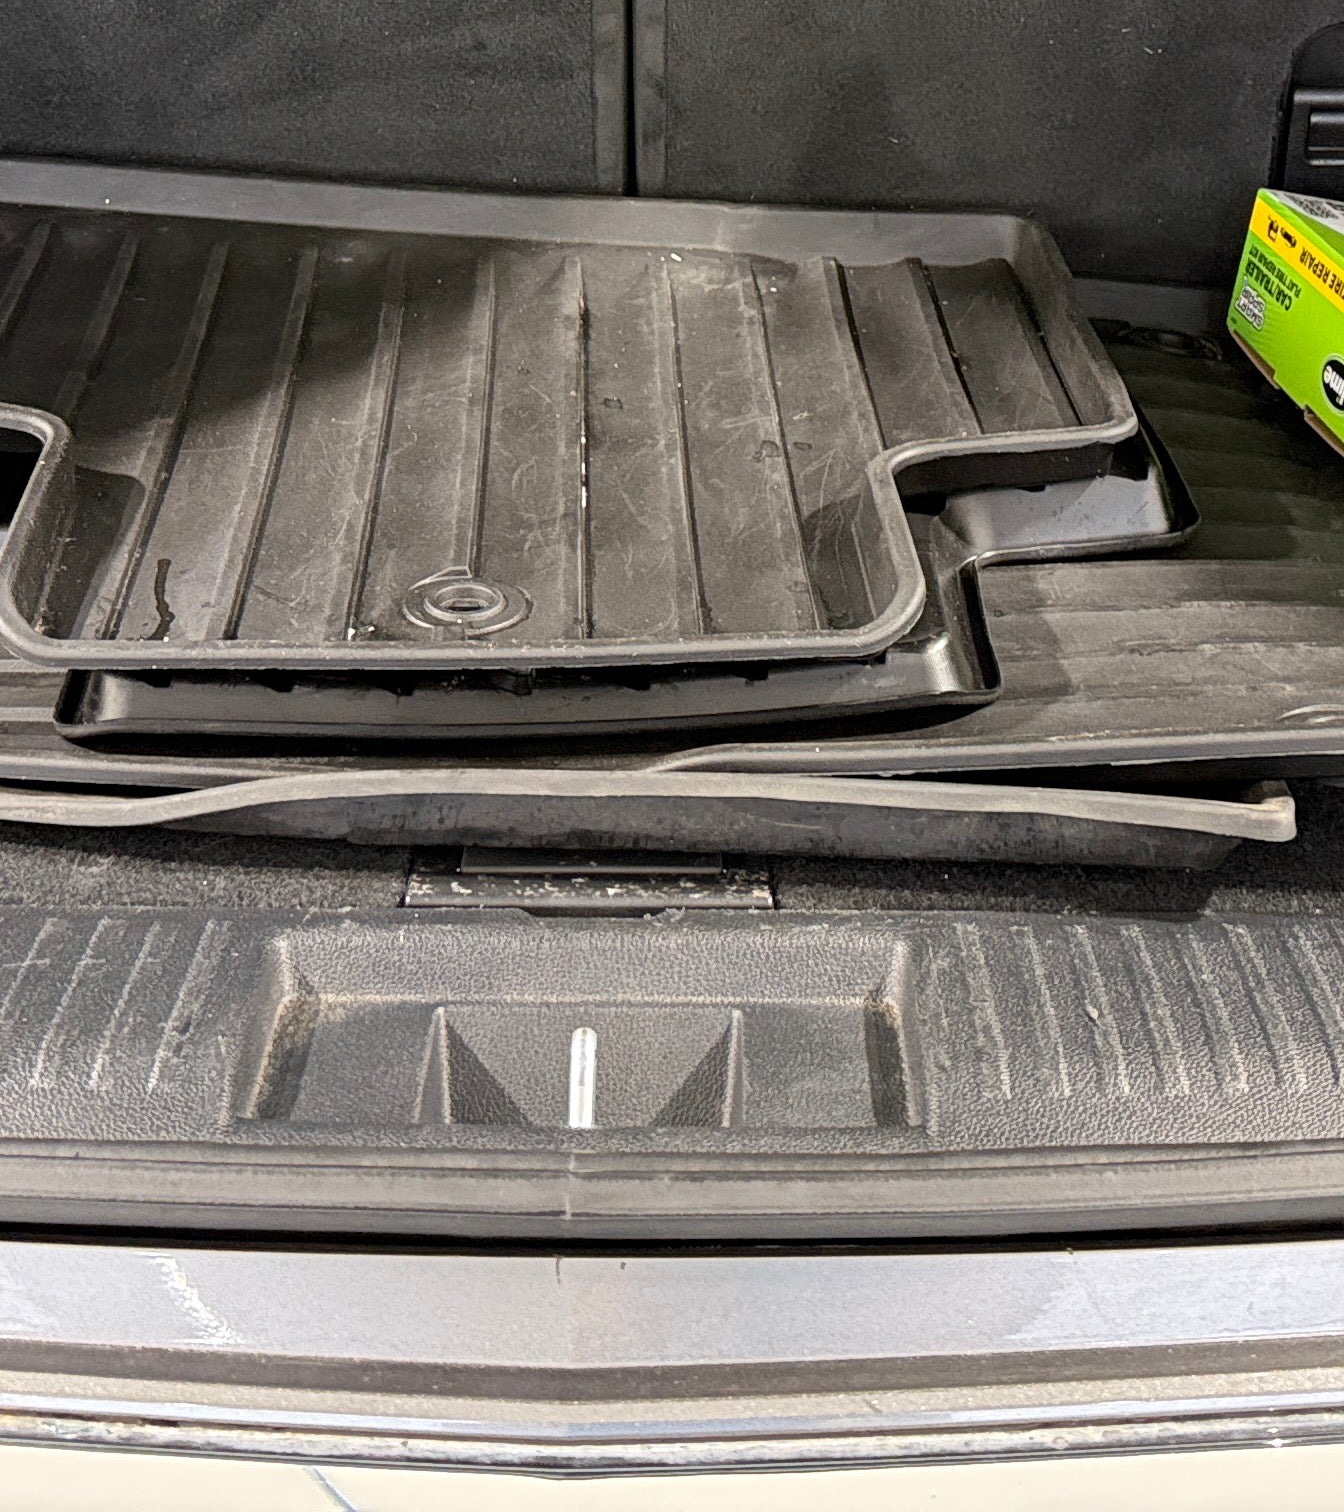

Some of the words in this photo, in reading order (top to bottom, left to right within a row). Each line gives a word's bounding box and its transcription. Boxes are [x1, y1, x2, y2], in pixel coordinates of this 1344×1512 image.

[1299, 247, 1330, 284] REPAIR
[1245, 259, 1292, 311] CAR/TRAILER
[1286, 279, 1301, 298] FLAT
